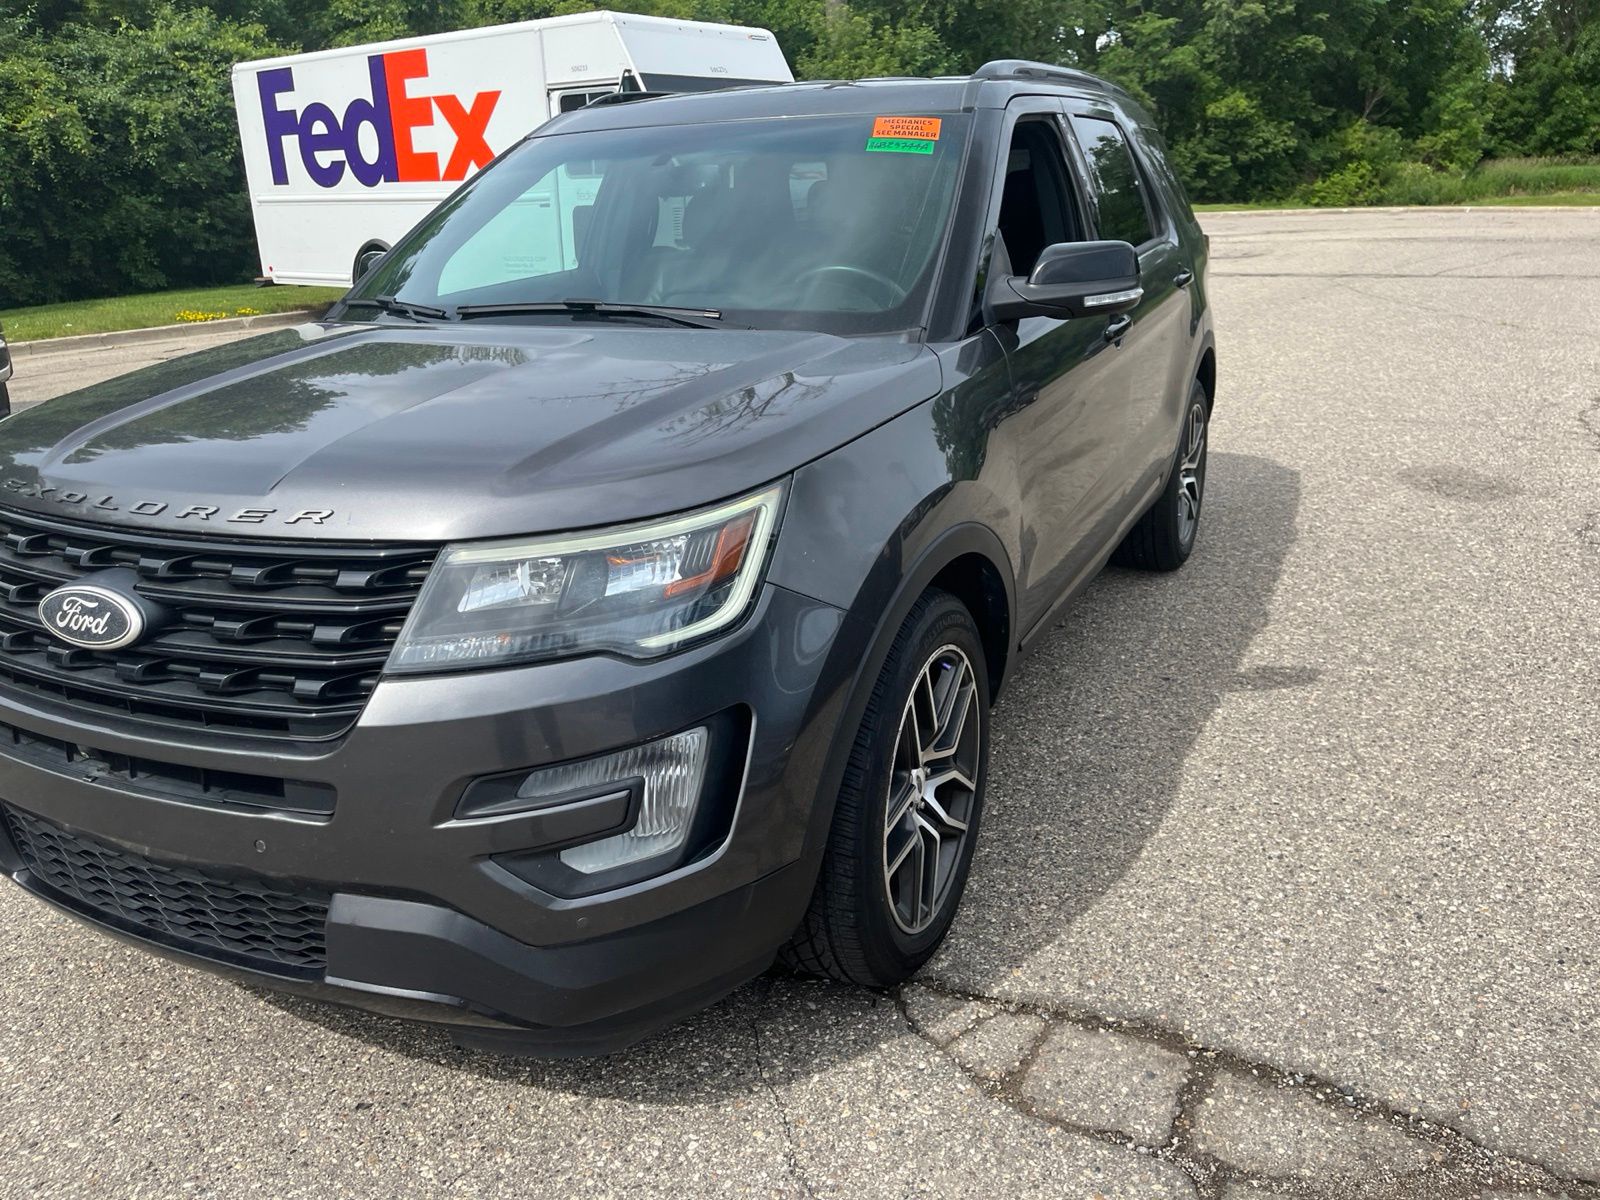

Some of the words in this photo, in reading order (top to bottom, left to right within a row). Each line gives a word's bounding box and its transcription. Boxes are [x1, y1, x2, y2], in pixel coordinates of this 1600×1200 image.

[255, 48, 502, 188] FedEx
[893, 130, 937, 138] MANAGER
[3, 478, 335, 525] EXPLORER
[56, 596, 109, 635] Ford
